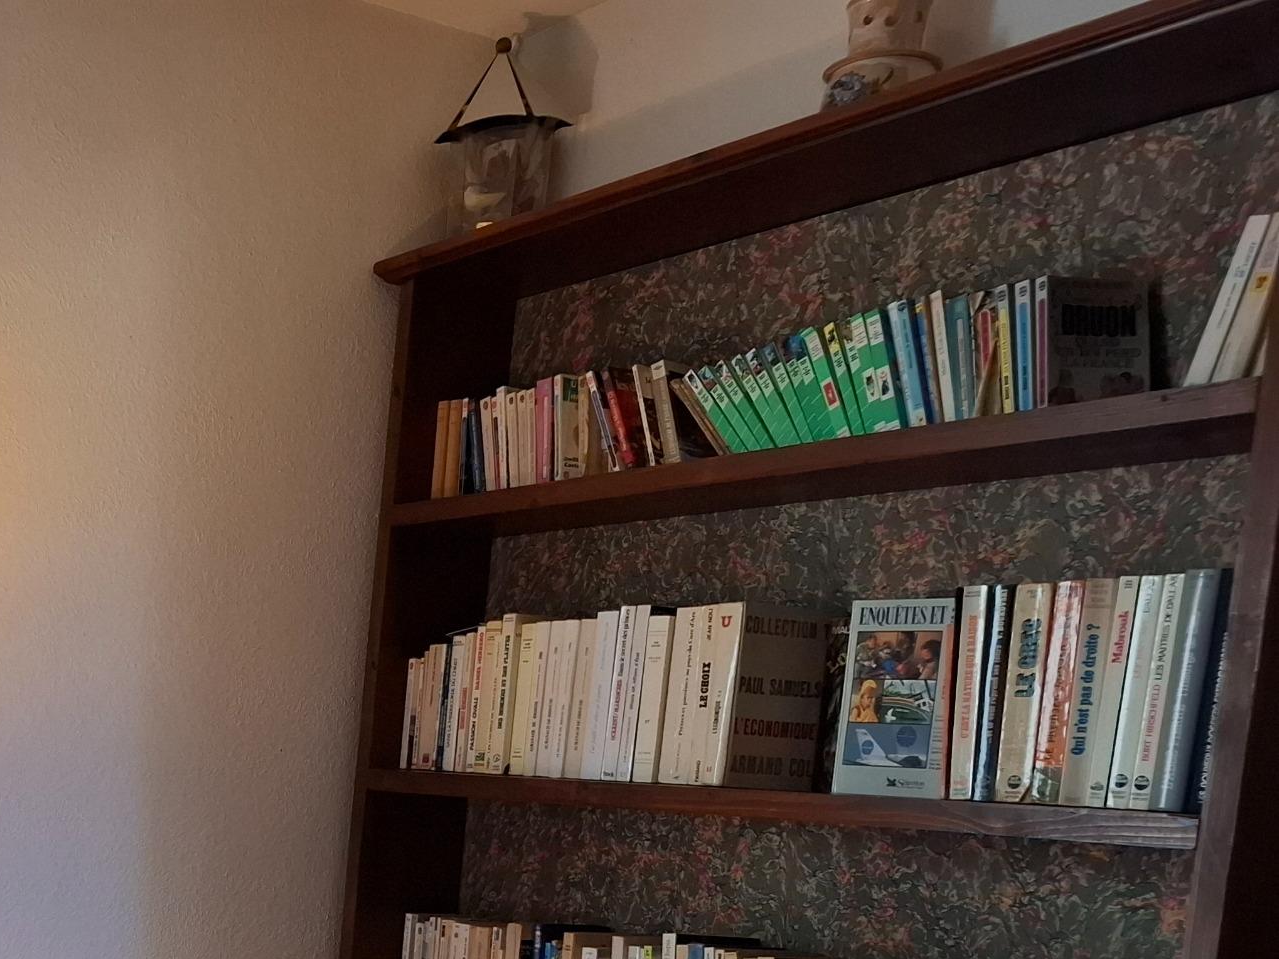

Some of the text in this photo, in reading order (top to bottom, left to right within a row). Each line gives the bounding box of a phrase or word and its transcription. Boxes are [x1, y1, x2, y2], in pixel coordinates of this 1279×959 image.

[721, 616, 732, 628] U
[745, 615, 818, 639] COLLECTION
[859, 605, 949, 625] ENQUÊTES ET
[1112, 609, 1129, 664] Mabrouk
[698, 661, 712, 708] LE CHOIX
[739, 676, 765, 695] PAUL
[964, 671, 973, 702] NATURE
[1013, 671, 1036, 698] LE
[1071, 622, 1099, 755] Qui n'est pas de droite ?
[1141, 740, 1152, 761] BURT
[1155, 663, 1164, 681] LES
[468, 720, 476, 750] PASSION
[734, 717, 818, 741] L'ECONOMIQUE
[960, 716, 969, 738] C'EST
[730, 754, 782, 777] ARMAND
